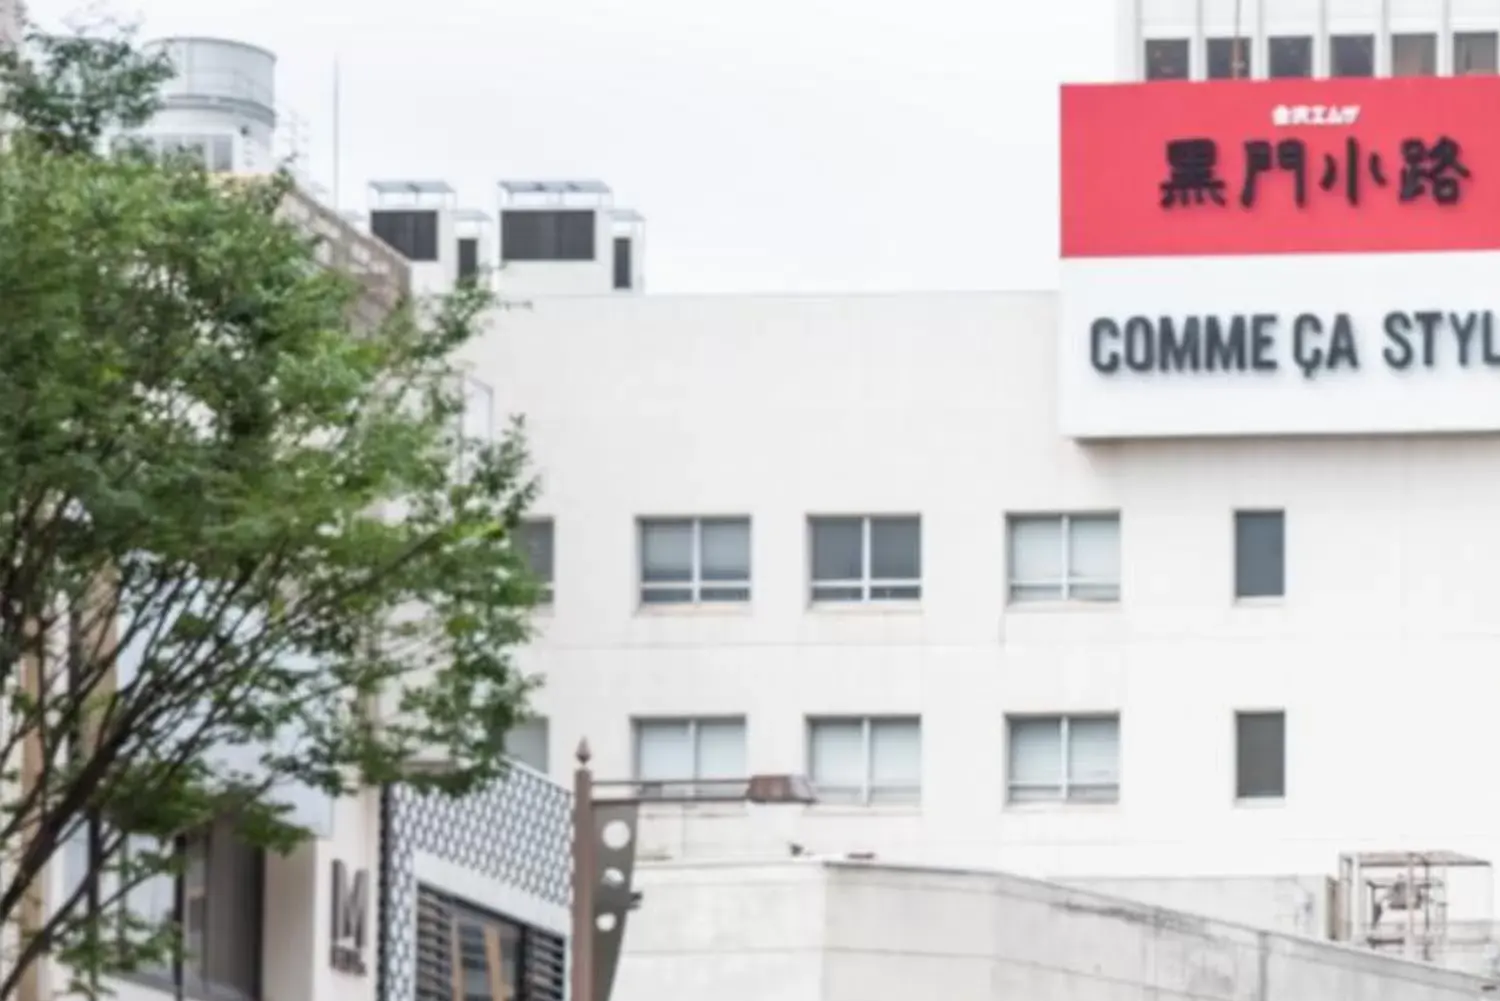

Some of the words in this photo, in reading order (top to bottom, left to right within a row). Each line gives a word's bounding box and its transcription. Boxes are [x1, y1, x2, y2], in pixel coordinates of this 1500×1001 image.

[1158, 135, 1471, 211] 黒門小路
[1090, 313, 1279, 375] COMME
[1293, 312, 1359, 379] ÇA
